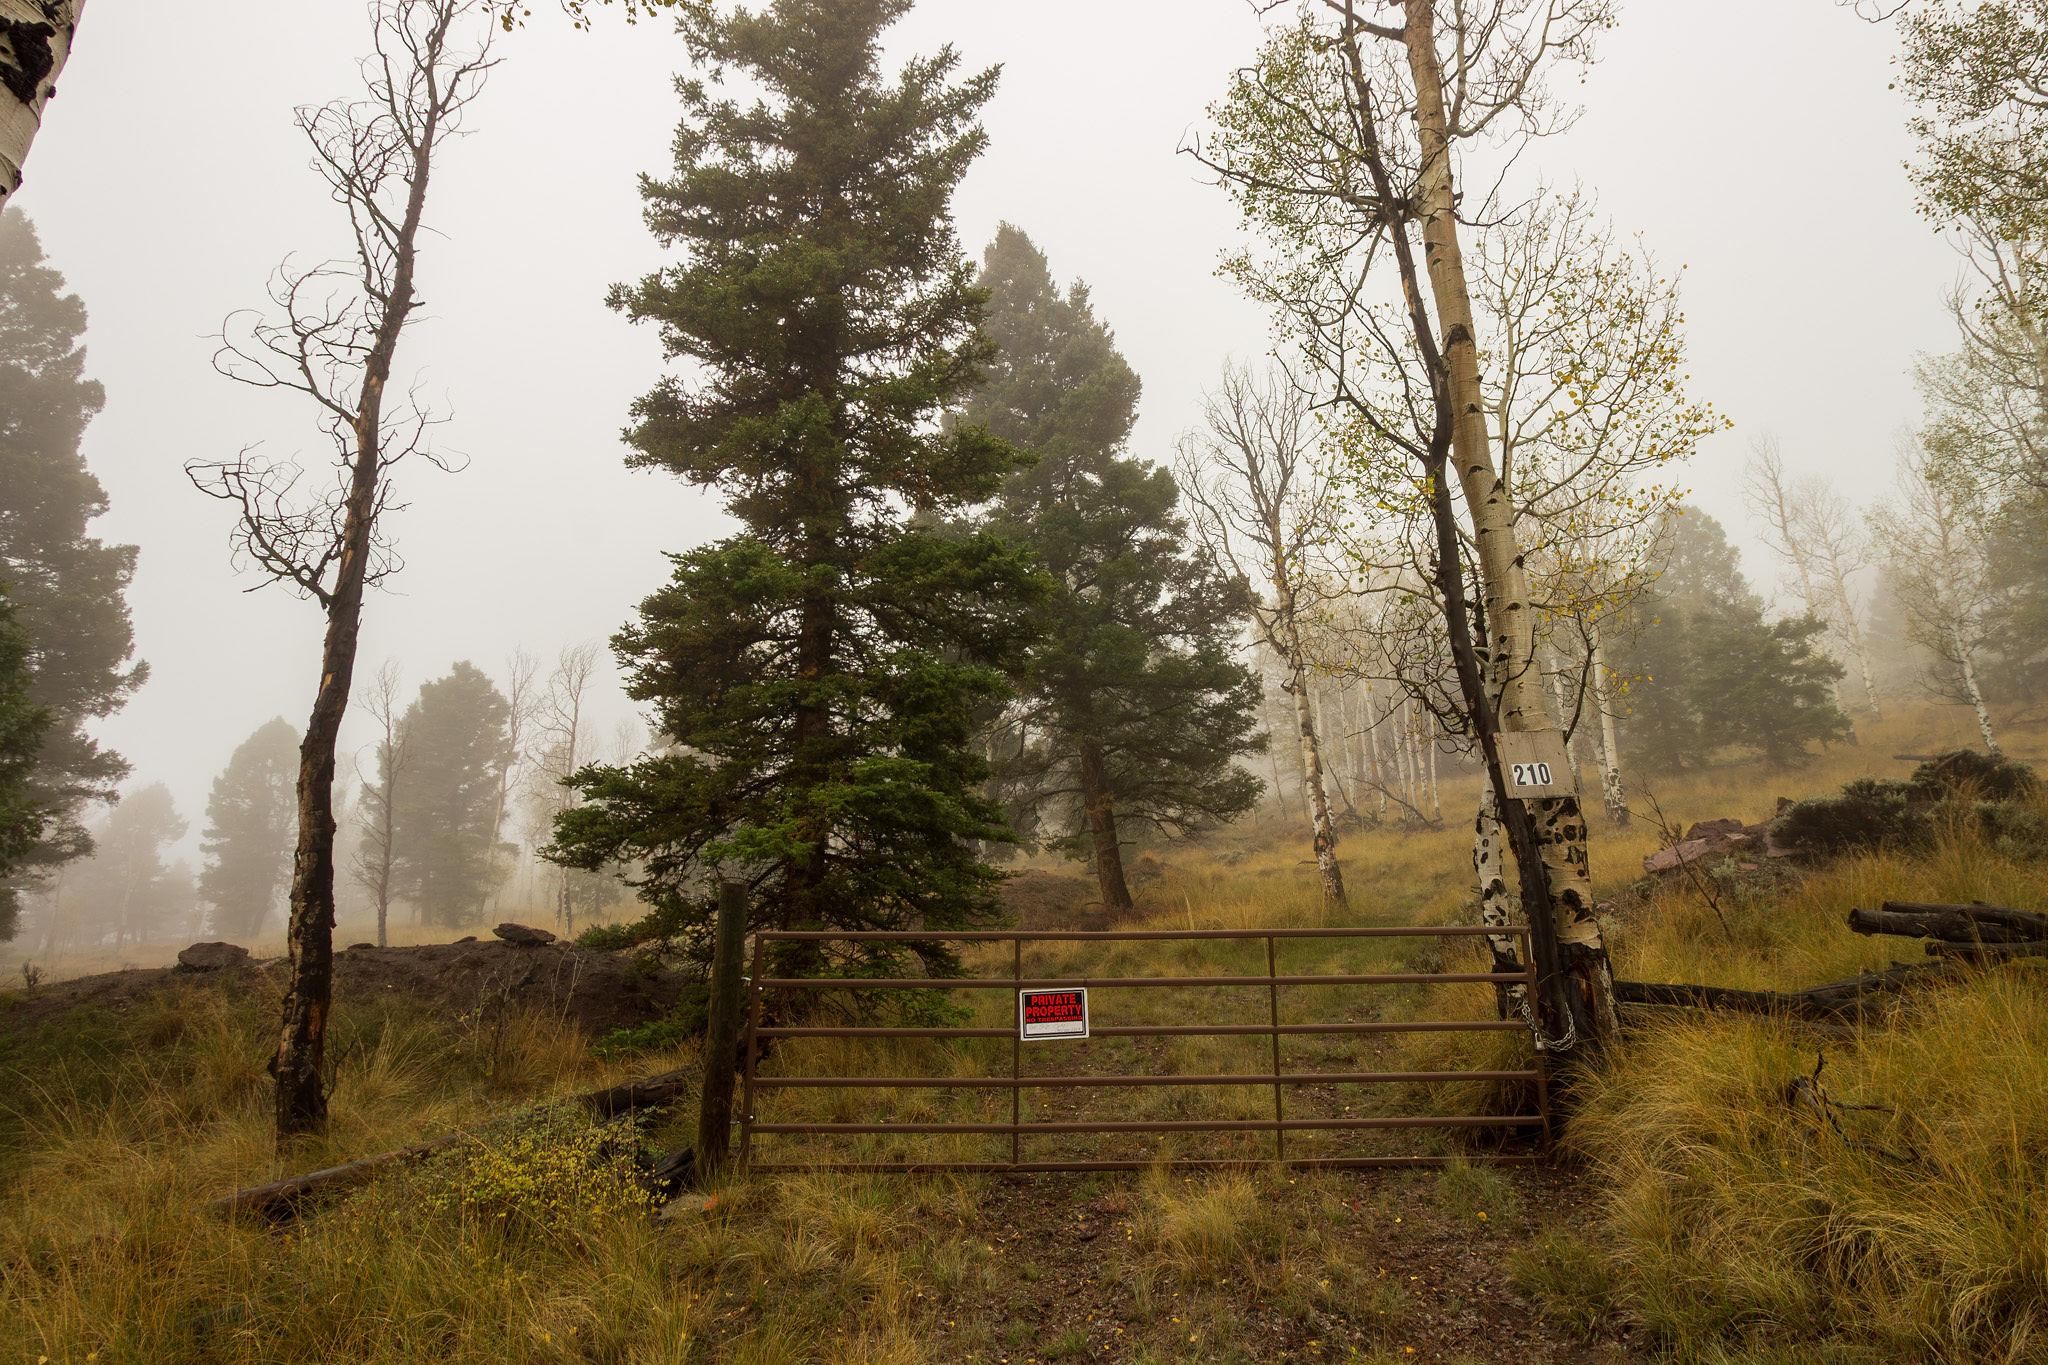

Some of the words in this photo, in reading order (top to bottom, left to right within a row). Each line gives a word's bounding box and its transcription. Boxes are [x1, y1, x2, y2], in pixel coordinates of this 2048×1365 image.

[1513, 763, 1551, 785] 210
[1031, 994, 1076, 1005] PRIVATE
[1026, 1005, 1081, 1017] PROPERTY
